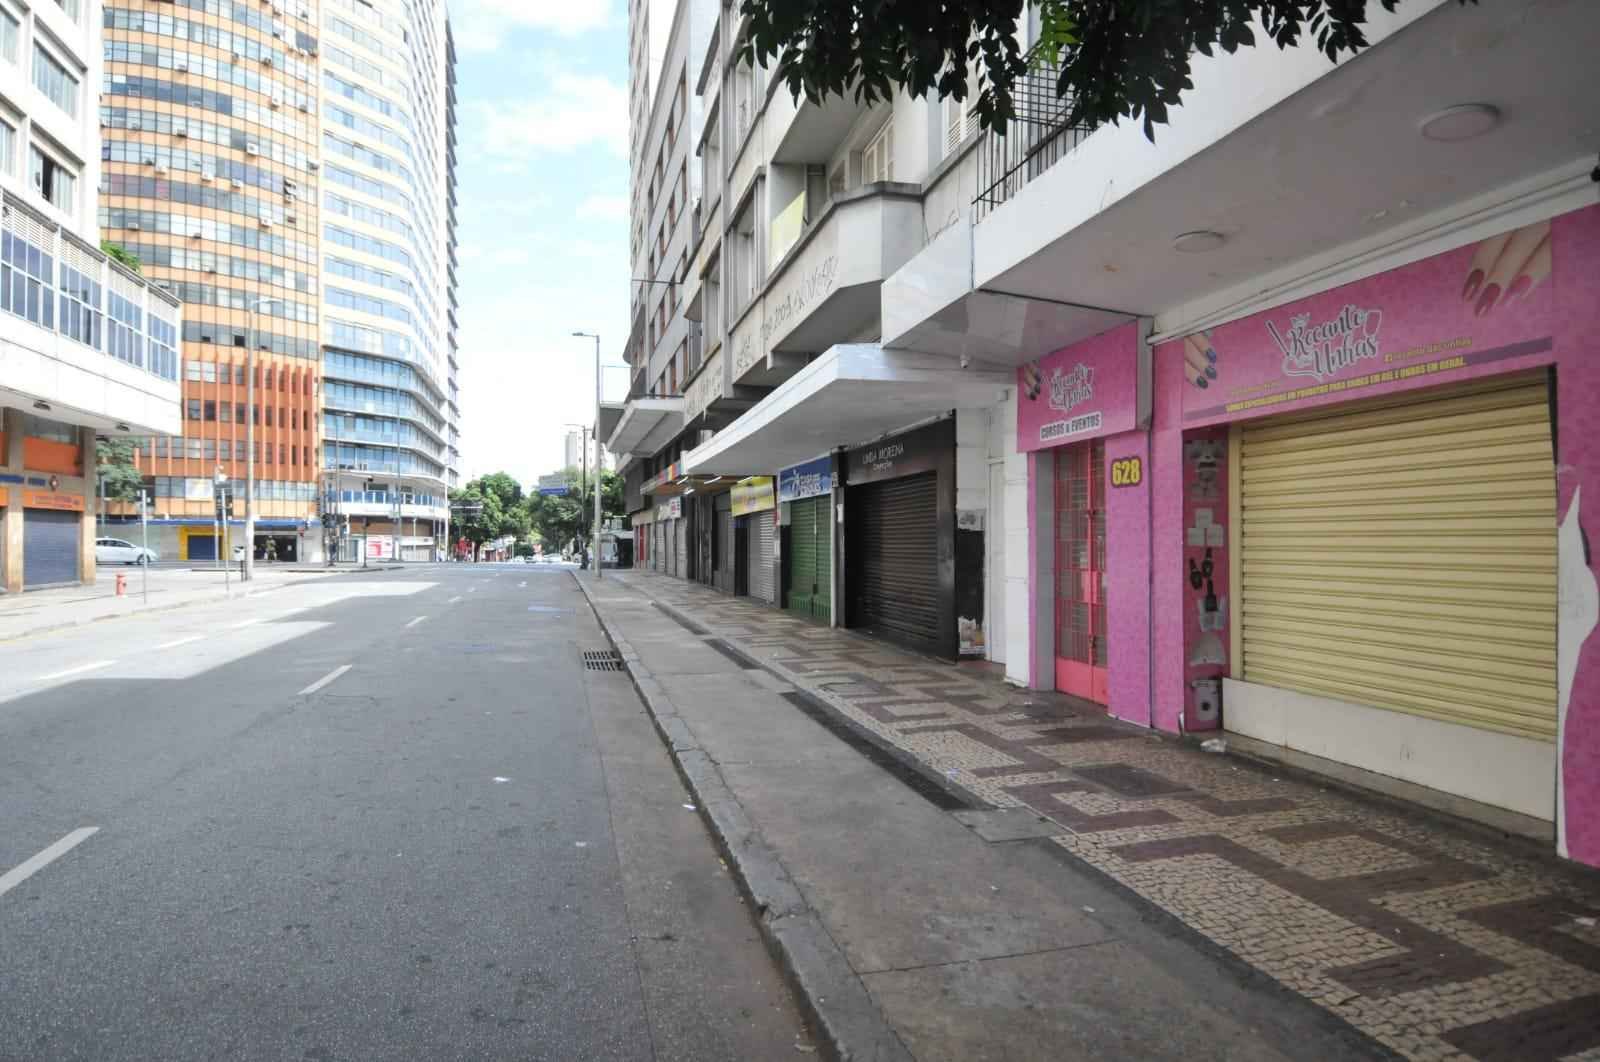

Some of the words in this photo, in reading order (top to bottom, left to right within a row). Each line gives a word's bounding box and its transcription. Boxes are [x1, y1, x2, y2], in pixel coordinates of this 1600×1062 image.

[1288, 305, 1367, 355] Recanto
[1313, 334, 1378, 376] Unhas
[1041, 423, 1065, 439] CURSOS
[1071, 413, 1100, 432] EVENTOS
[1112, 459, 1141, 486] 628
